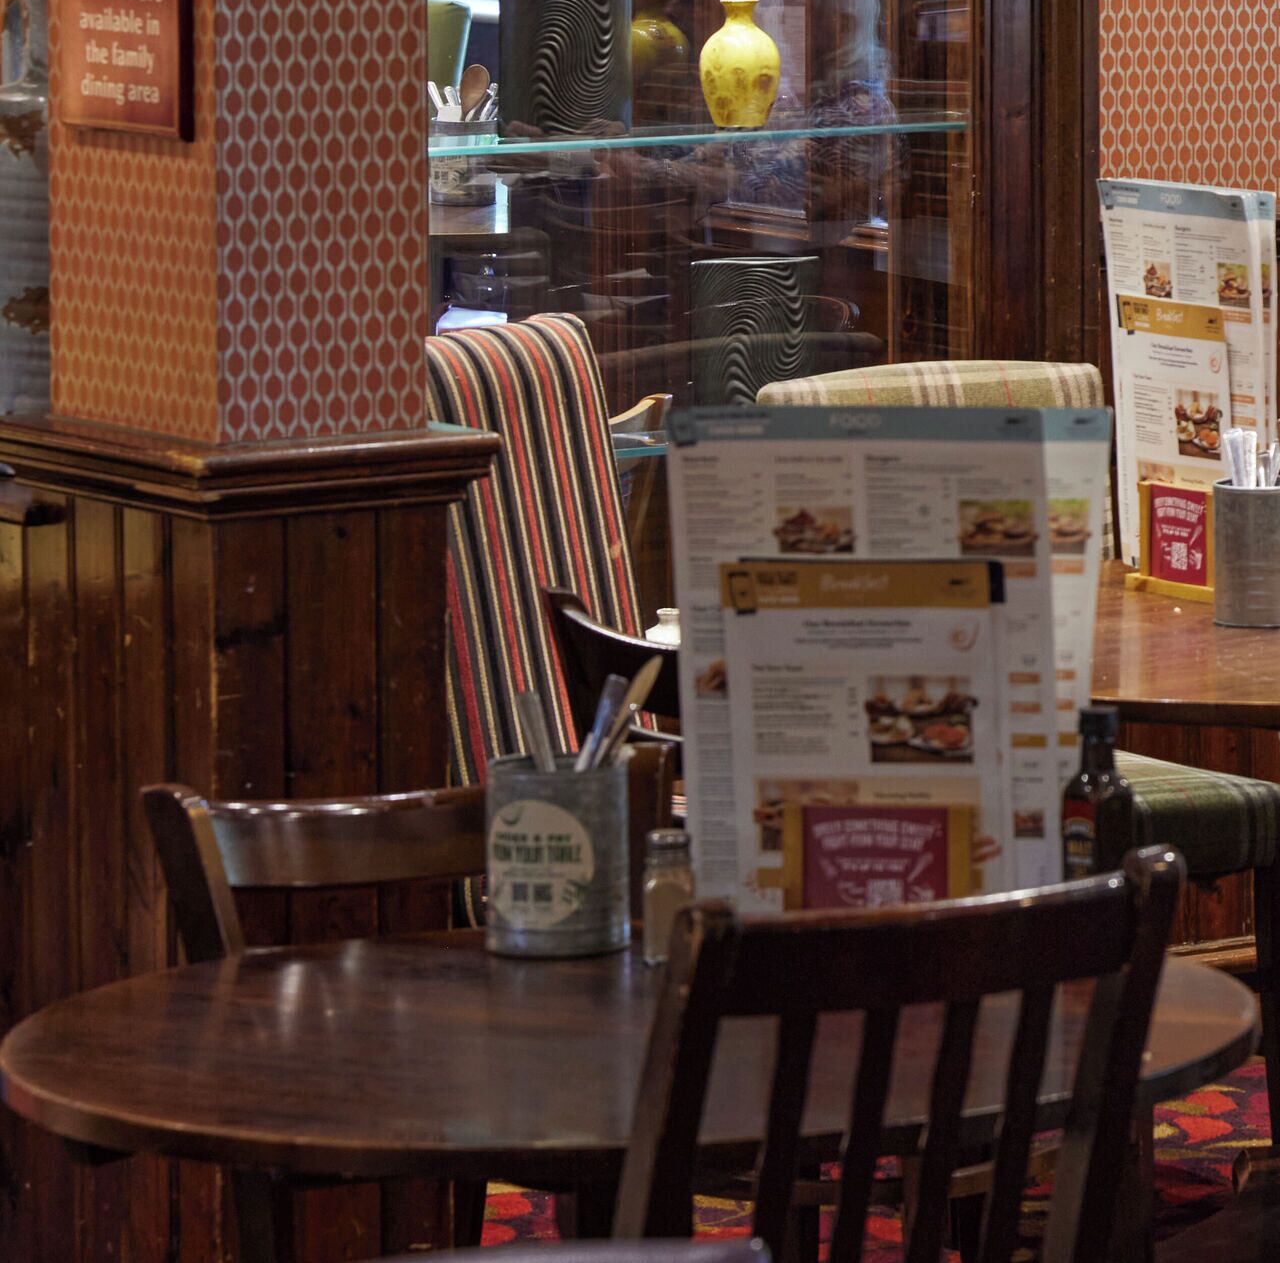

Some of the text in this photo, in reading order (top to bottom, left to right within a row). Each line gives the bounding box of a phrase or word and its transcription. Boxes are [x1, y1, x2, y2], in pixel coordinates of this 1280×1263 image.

[79, 8, 160, 35] available in
[86, 40, 155, 74] the family
[81, 73, 160, 105] dining area
[1160, 192, 1183, 204] FOOD
